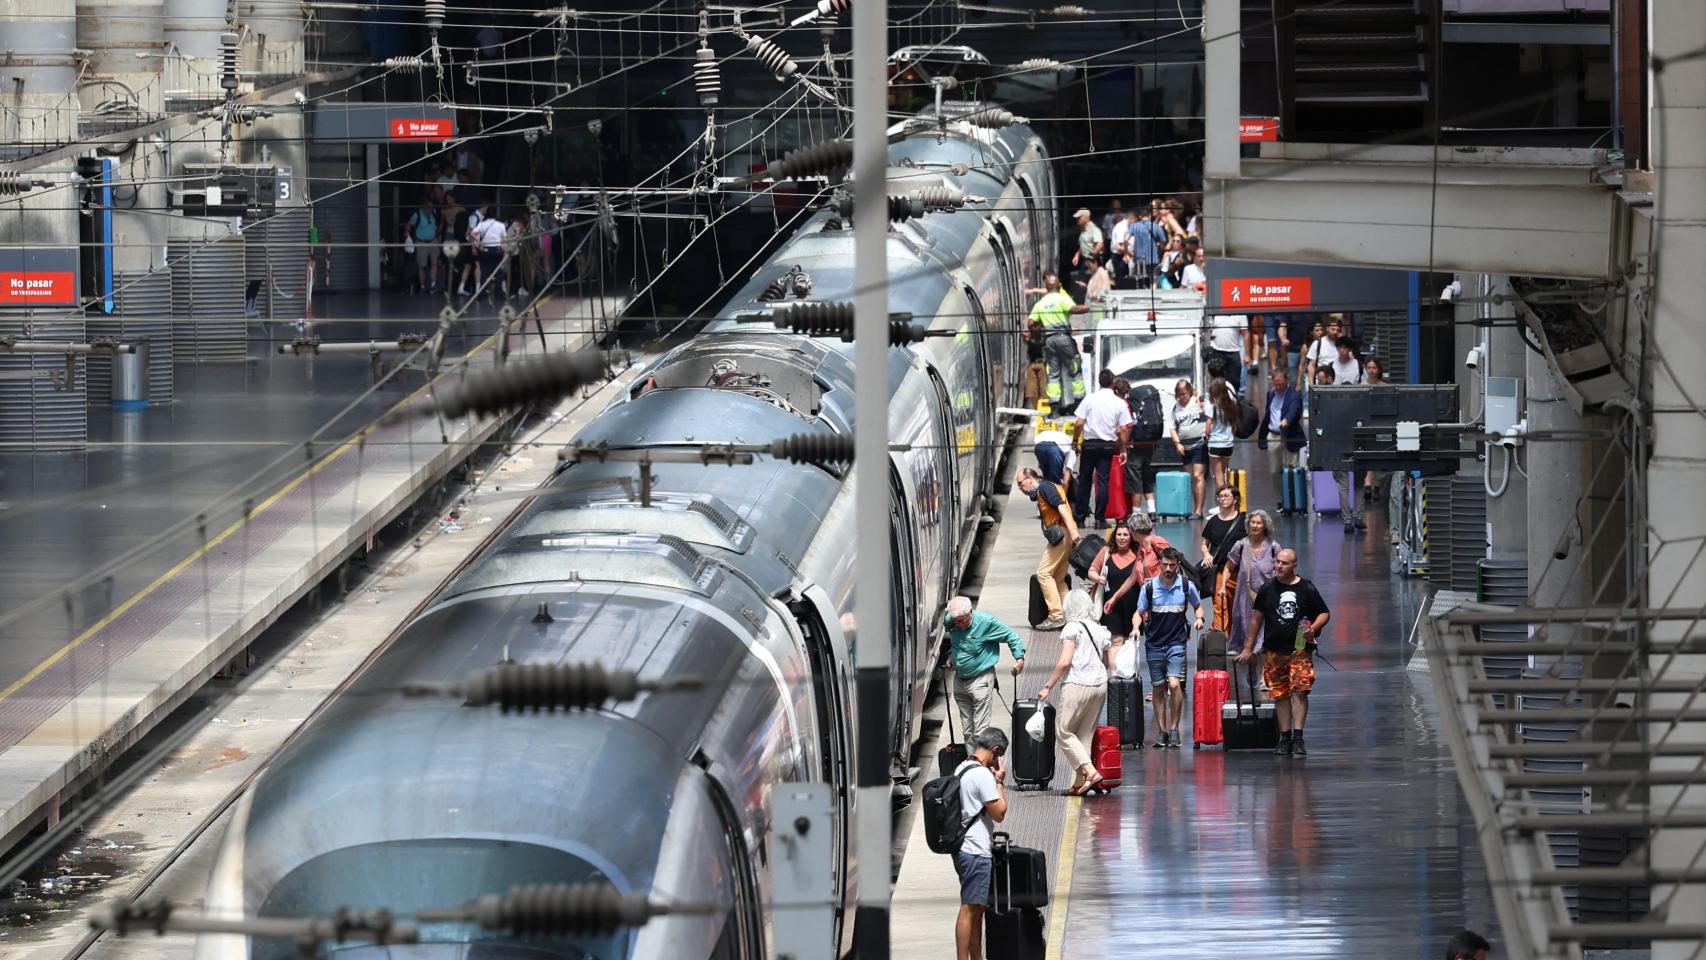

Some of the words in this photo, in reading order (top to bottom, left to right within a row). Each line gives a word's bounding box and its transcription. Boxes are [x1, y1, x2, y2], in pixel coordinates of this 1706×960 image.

[280, 182, 289, 199] 3
[11, 278, 23, 287] No
[27, 279, 53, 289] pasar
[1249, 285, 1263, 294] No
[1265, 286, 1291, 295] pasar
